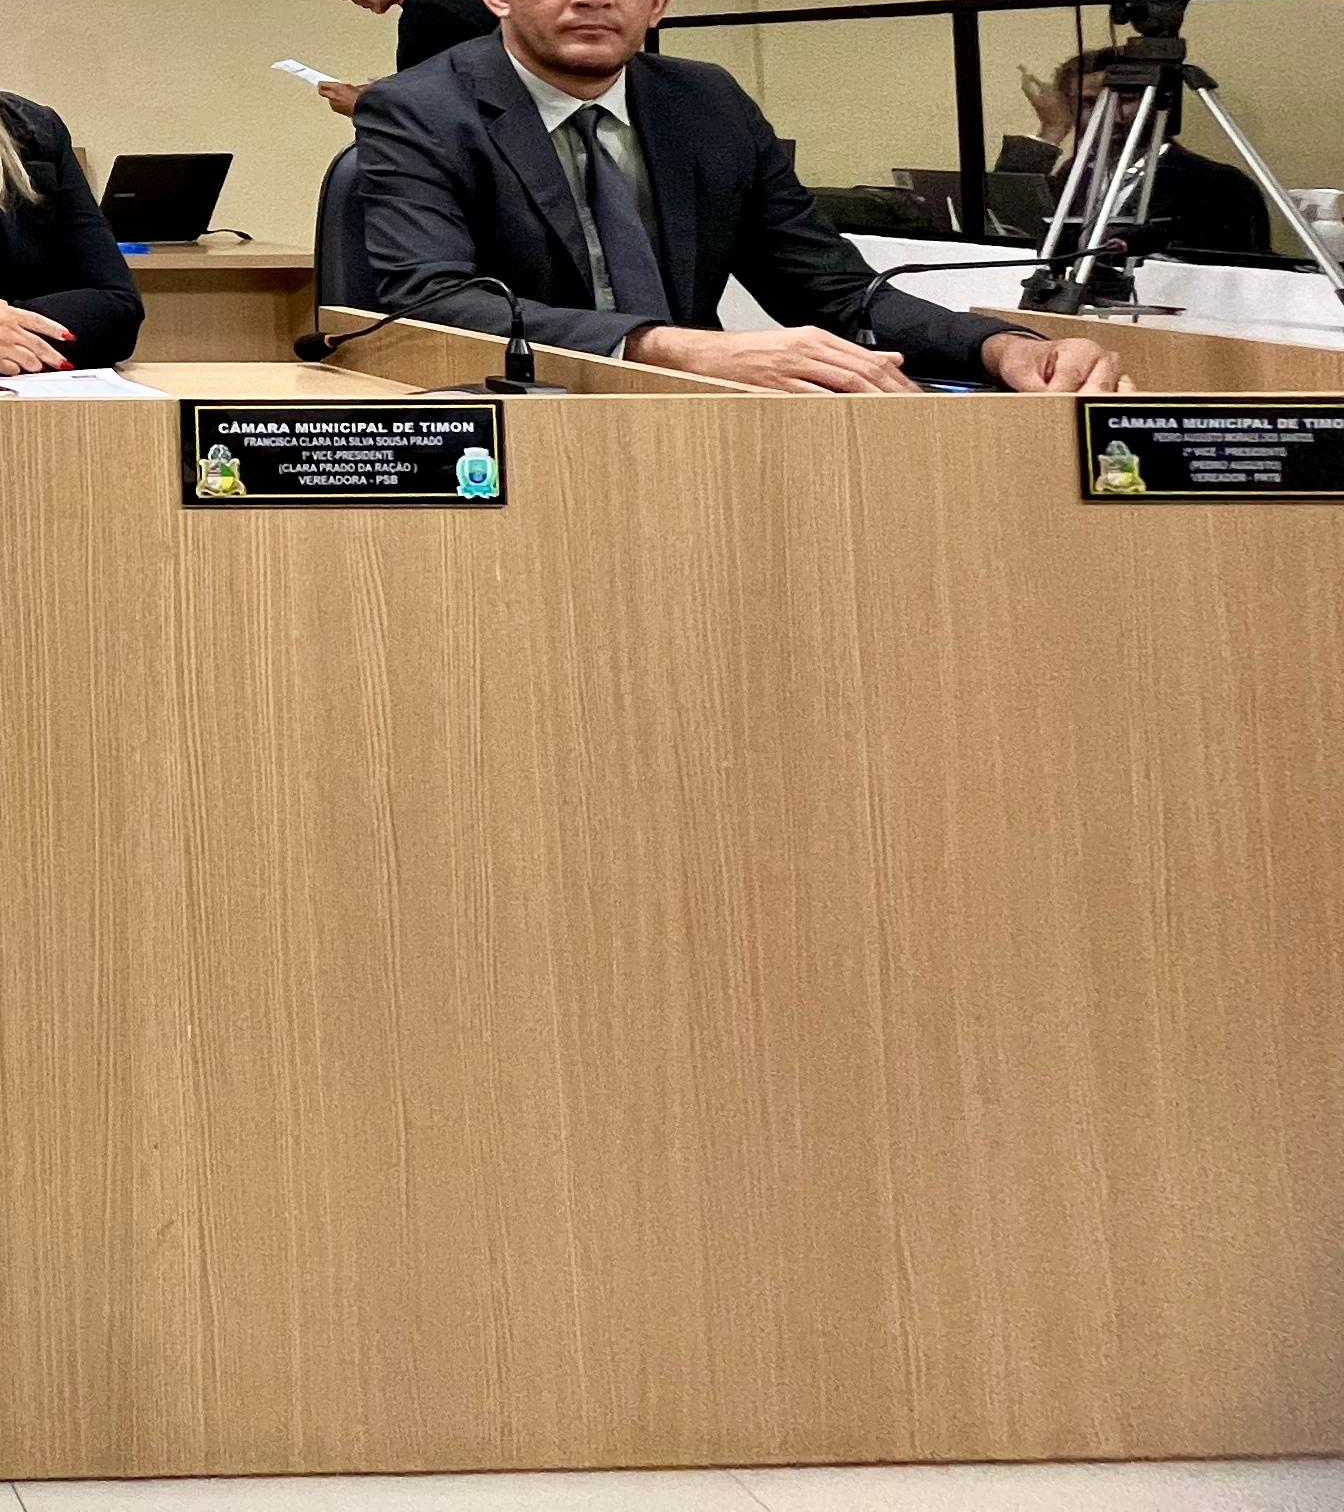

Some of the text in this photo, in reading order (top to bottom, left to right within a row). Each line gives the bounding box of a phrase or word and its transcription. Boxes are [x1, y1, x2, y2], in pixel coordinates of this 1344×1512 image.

[217, 420, 475, 434] CÂMARA MUNICIPAL DE TIMON
[1107, 416, 1344, 430] CÂMARA MUNICIPAL DE TIMO
[333, 437, 348, 447] DA
[319, 463, 356, 474] PRADO
[357, 463, 373, 473] DA
[297, 475, 368, 486] VEREADORA
